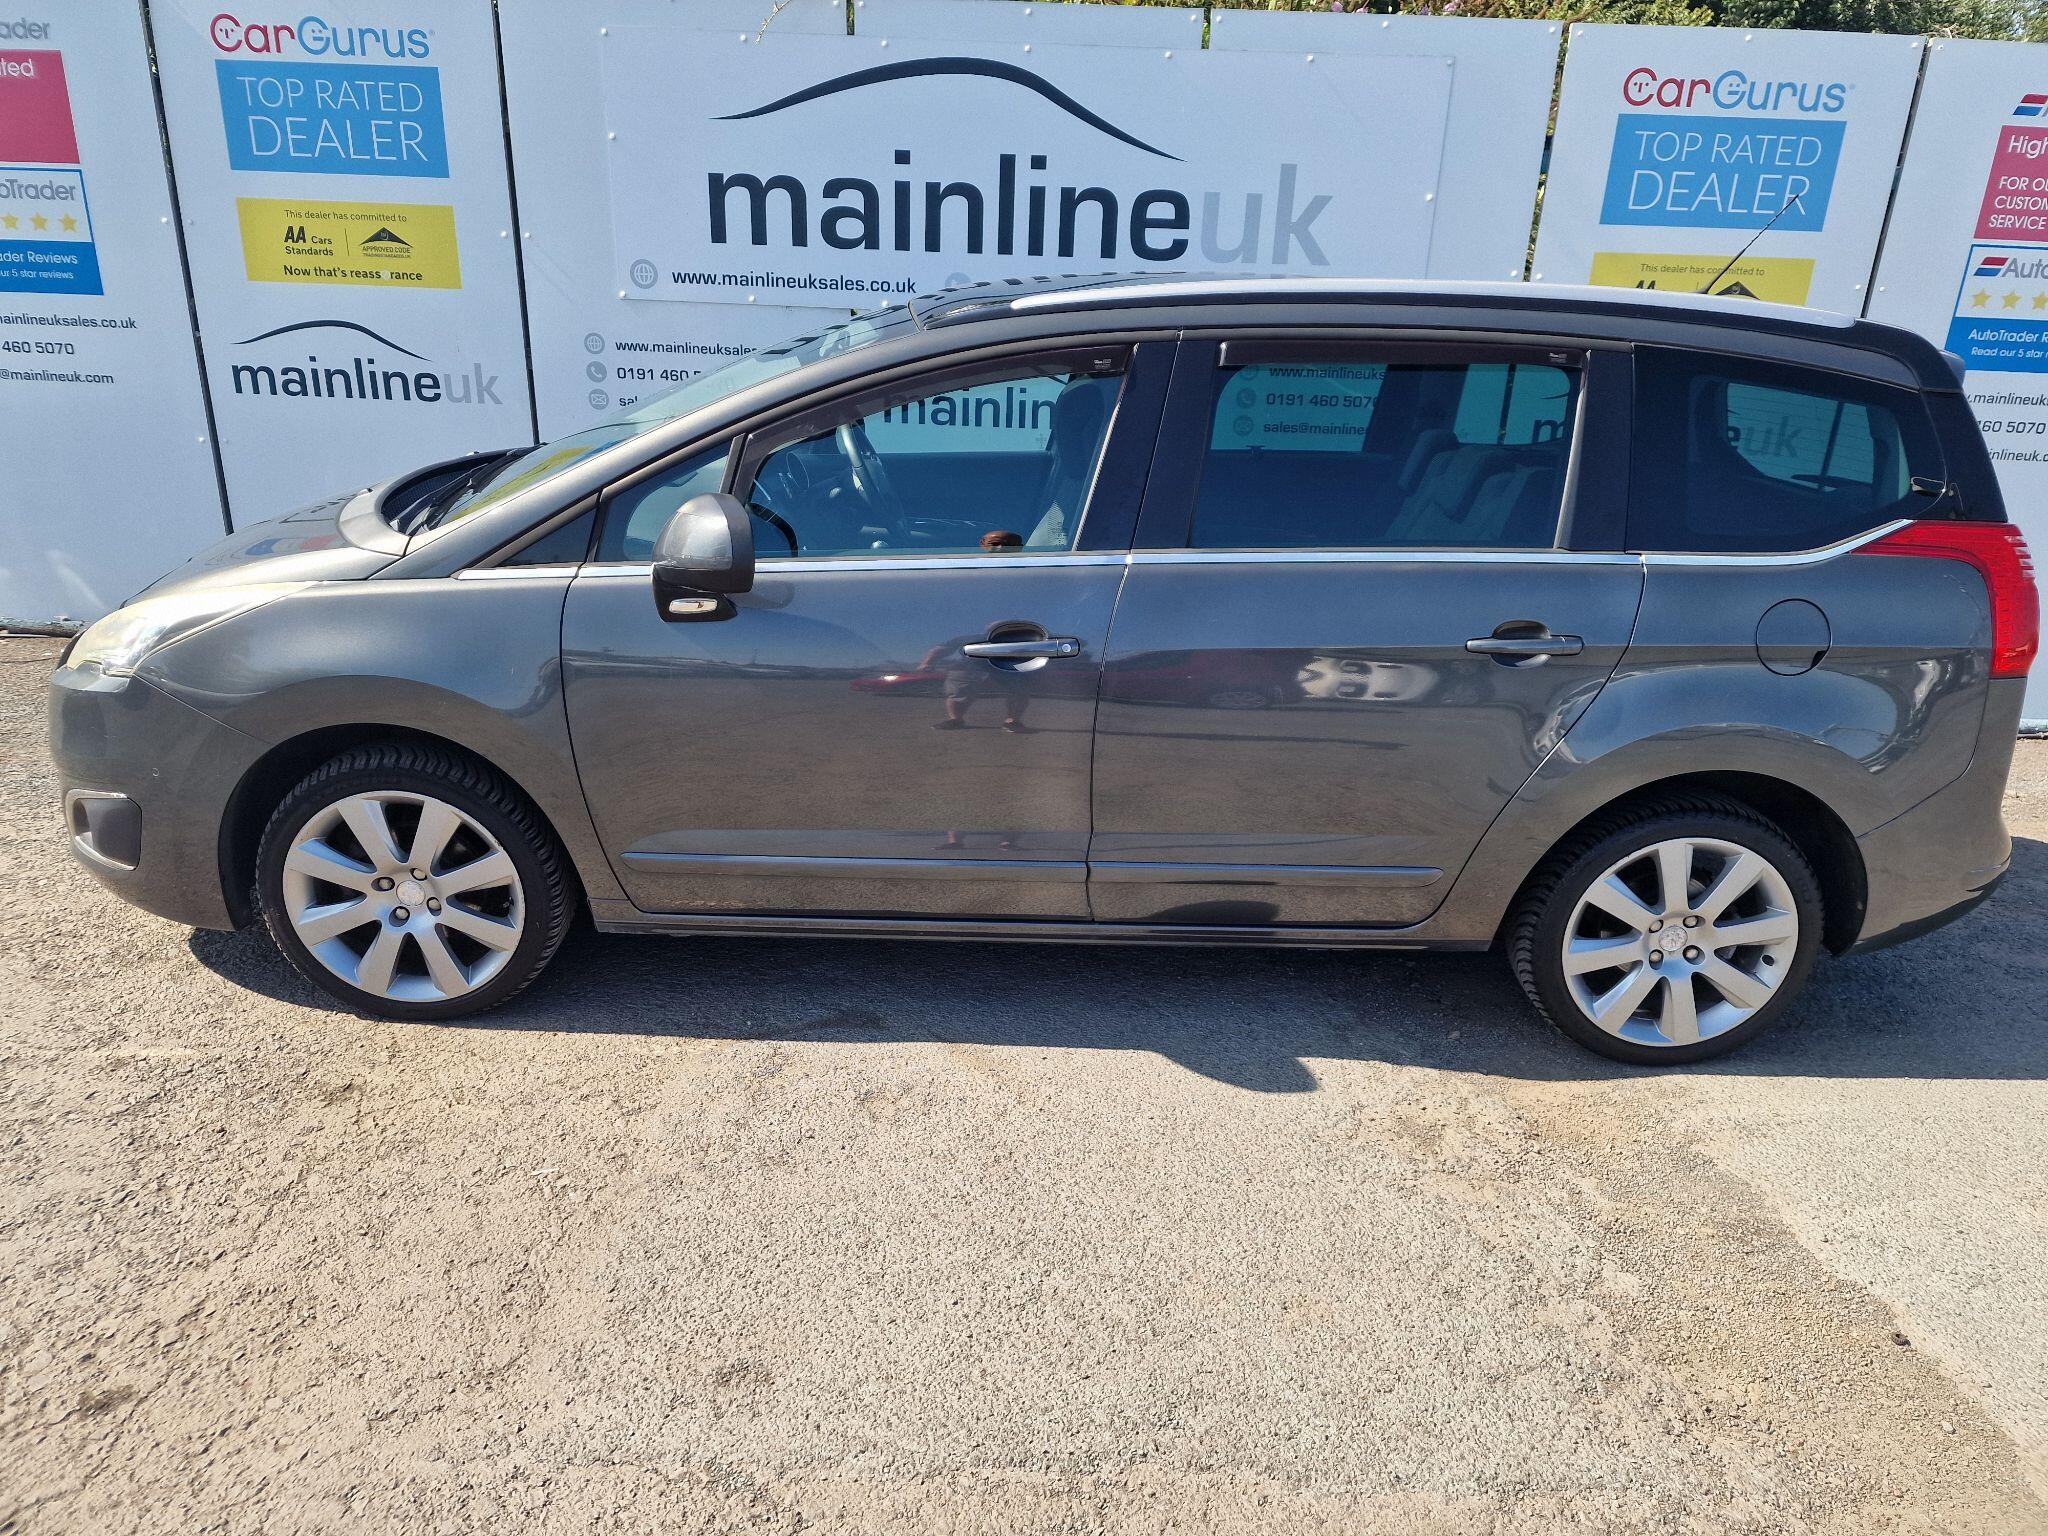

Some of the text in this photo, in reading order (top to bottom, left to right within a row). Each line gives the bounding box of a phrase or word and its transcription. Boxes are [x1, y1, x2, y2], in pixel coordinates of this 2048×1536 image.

[210, 13, 431, 59] CarGurus
[236, 76, 423, 113] TOP RATED
[1623, 67, 1846, 113] CarGurus
[248, 115, 429, 162] DEALER
[1635, 131, 1823, 167] TOP RATED
[1999, 176, 2029, 191] FOR
[1628, 169, 1810, 216] DEALER
[284, 209, 407, 222] This dealer has committed to
[707, 149, 1334, 266] mainlineuk
[1988, 214, 2047, 230] SERVICE
[284, 226, 333, 245] AA Cars
[27, 251, 78, 265] Reviews
[285, 246, 334, 256] Standards
[12, 268, 18, 277] 5
[20, 269, 37, 279] star
[39, 270, 74, 280] reviews
[284, 264, 423, 281] Now that's reassrance
[1640, 263, 1658, 272] This
[1661, 264, 1688, 273] dealer
[1690, 265, 1705, 274] has
[1756, 267, 1765, 276] to
[671, 270, 917, 294] www.mainlineuksales.co.uk
[0, 313, 138, 329] ainlineuksales.co.uk
[1968, 328, 2039, 343] AutoTrader
[2, 340, 75, 355] 460 5070
[1971, 346, 1999, 356] Read
[2000, 348, 2016, 357] our
[2017, 348, 2024, 357] 5
[2026, 349, 2044, 359] star
[231, 355, 504, 405] mainlineuk
[616, 367, 654, 381] 0191
[660, 369, 689, 382] 460
[1266, 392, 1304, 406] 0191
[1309, 393, 1339, 407] 460
[2006, 421, 2047, 435] 5070
